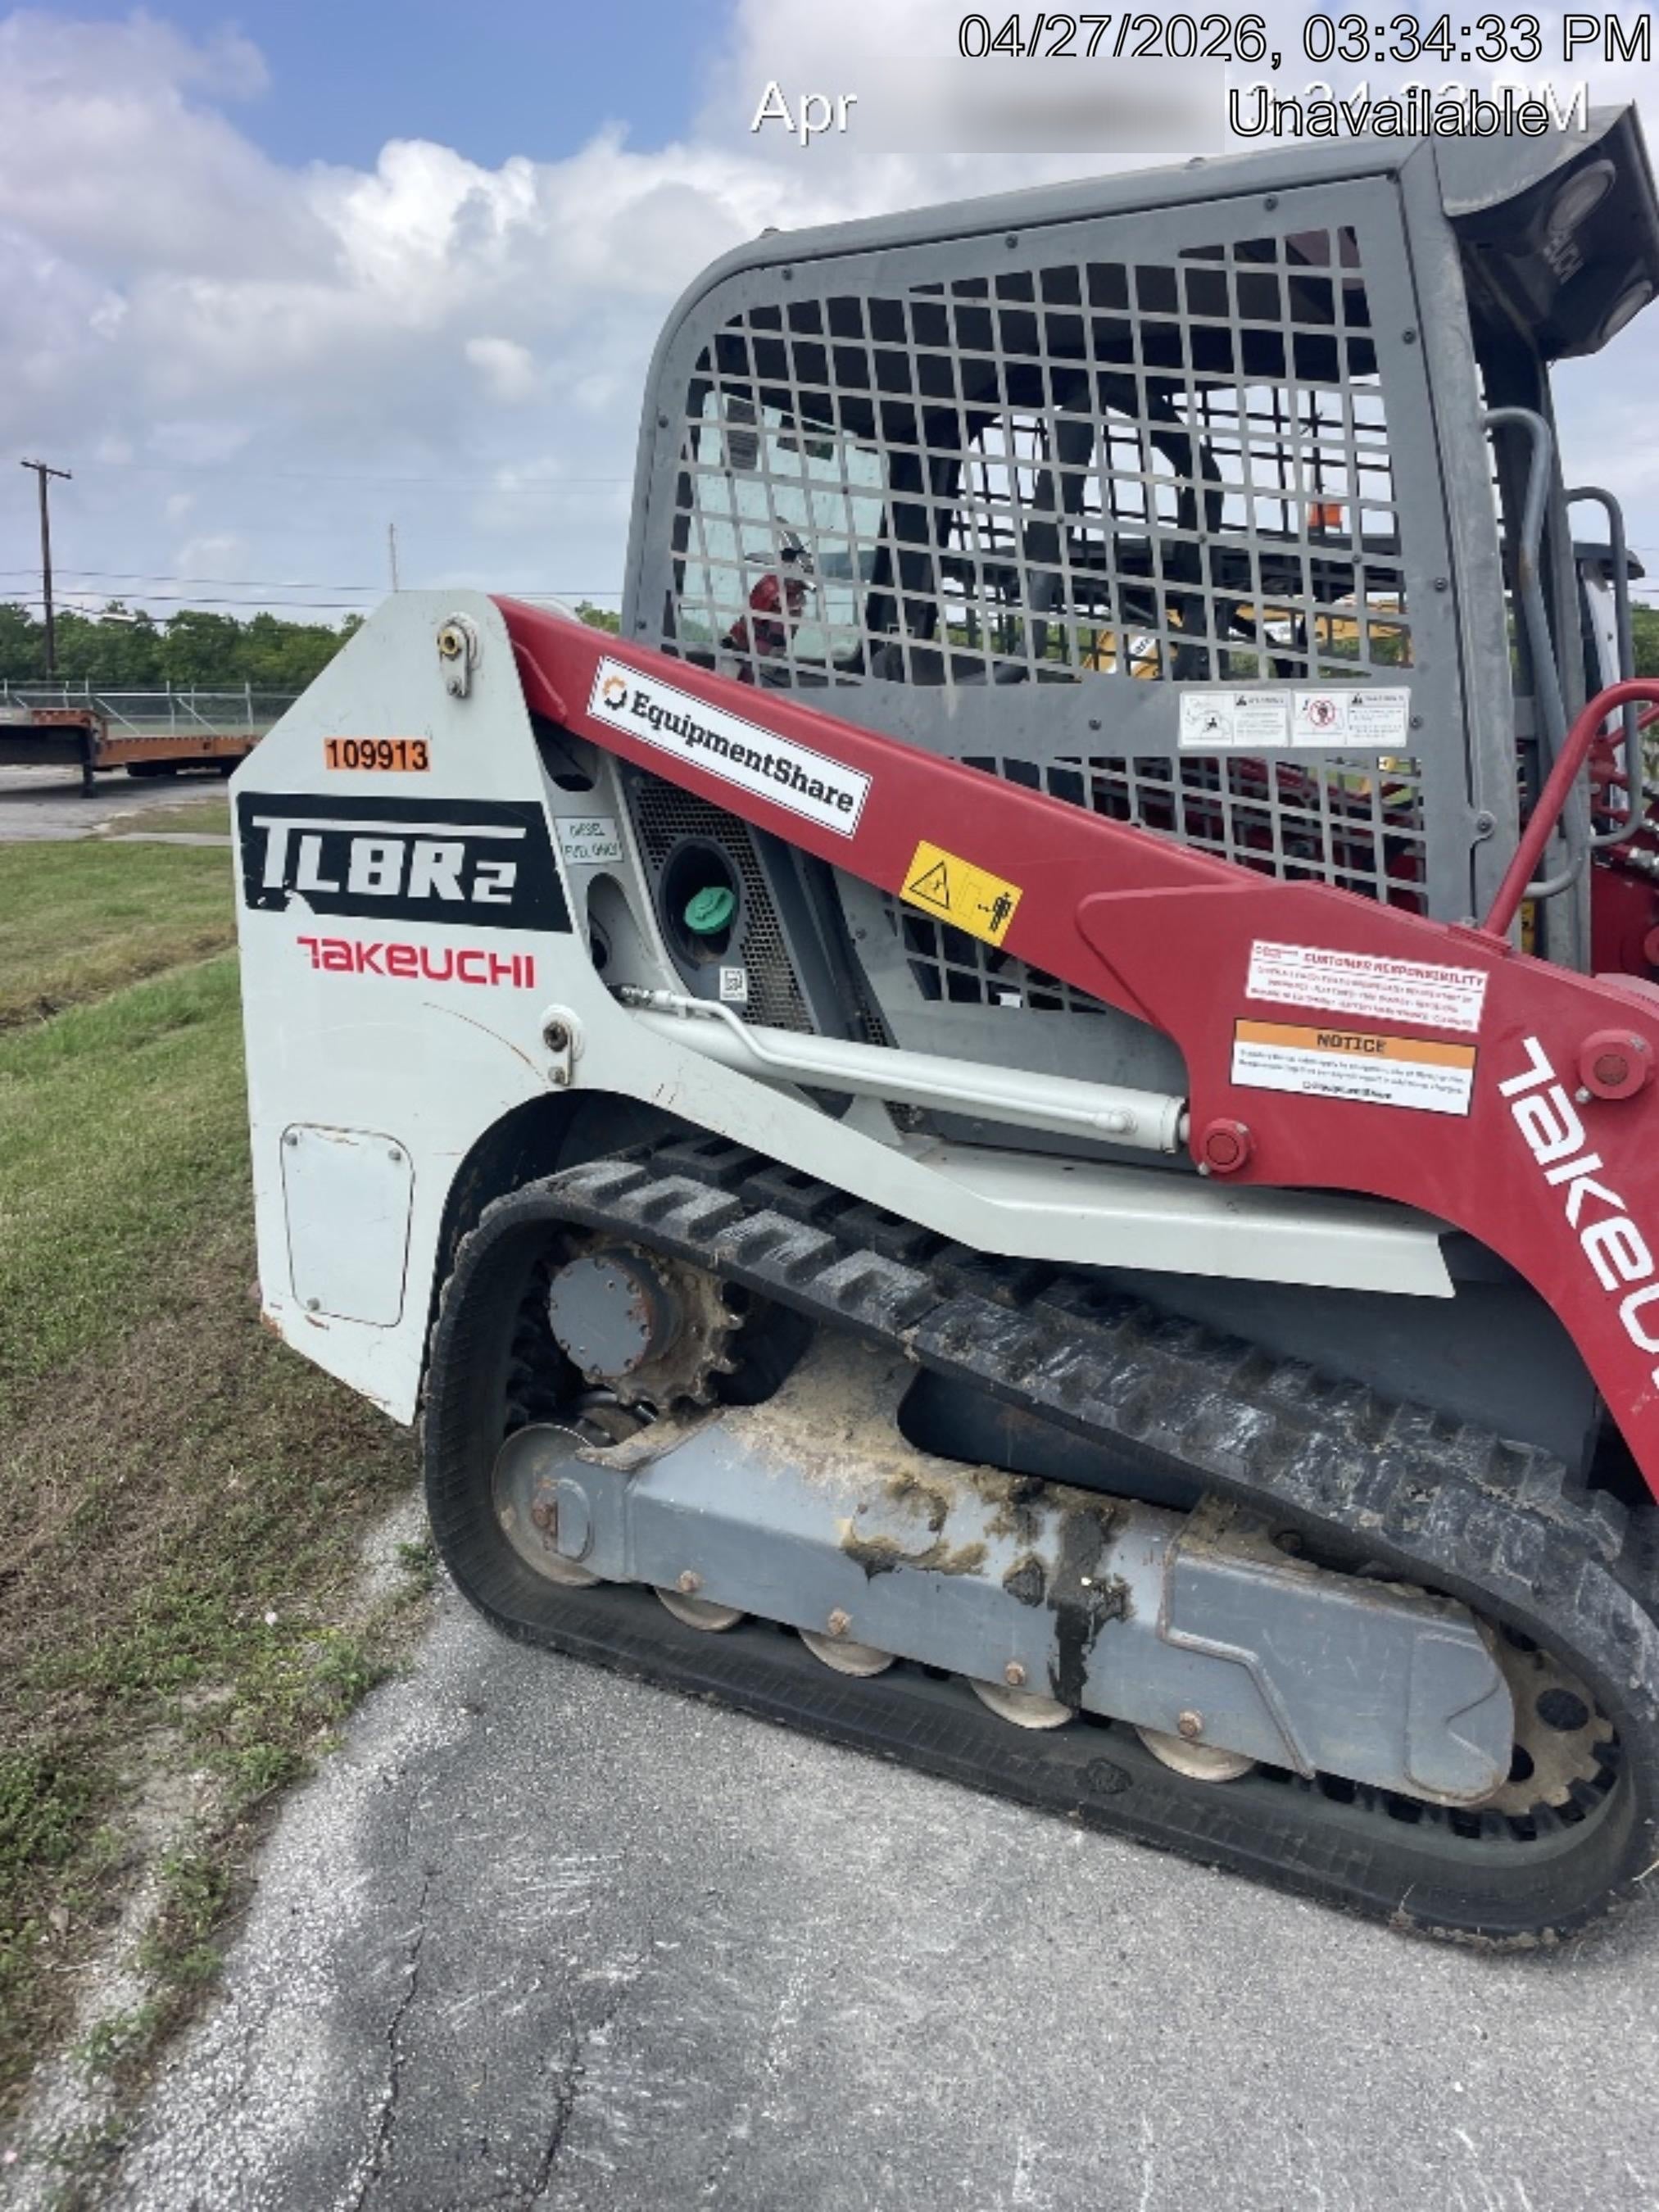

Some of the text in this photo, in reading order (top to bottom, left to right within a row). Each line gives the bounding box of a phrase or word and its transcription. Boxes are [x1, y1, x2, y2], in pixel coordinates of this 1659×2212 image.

[327, 739, 429, 770] 109913
[630, 690, 854, 813] EquipmentShare
[1317, 1033, 1387, 1053] NOTICE
